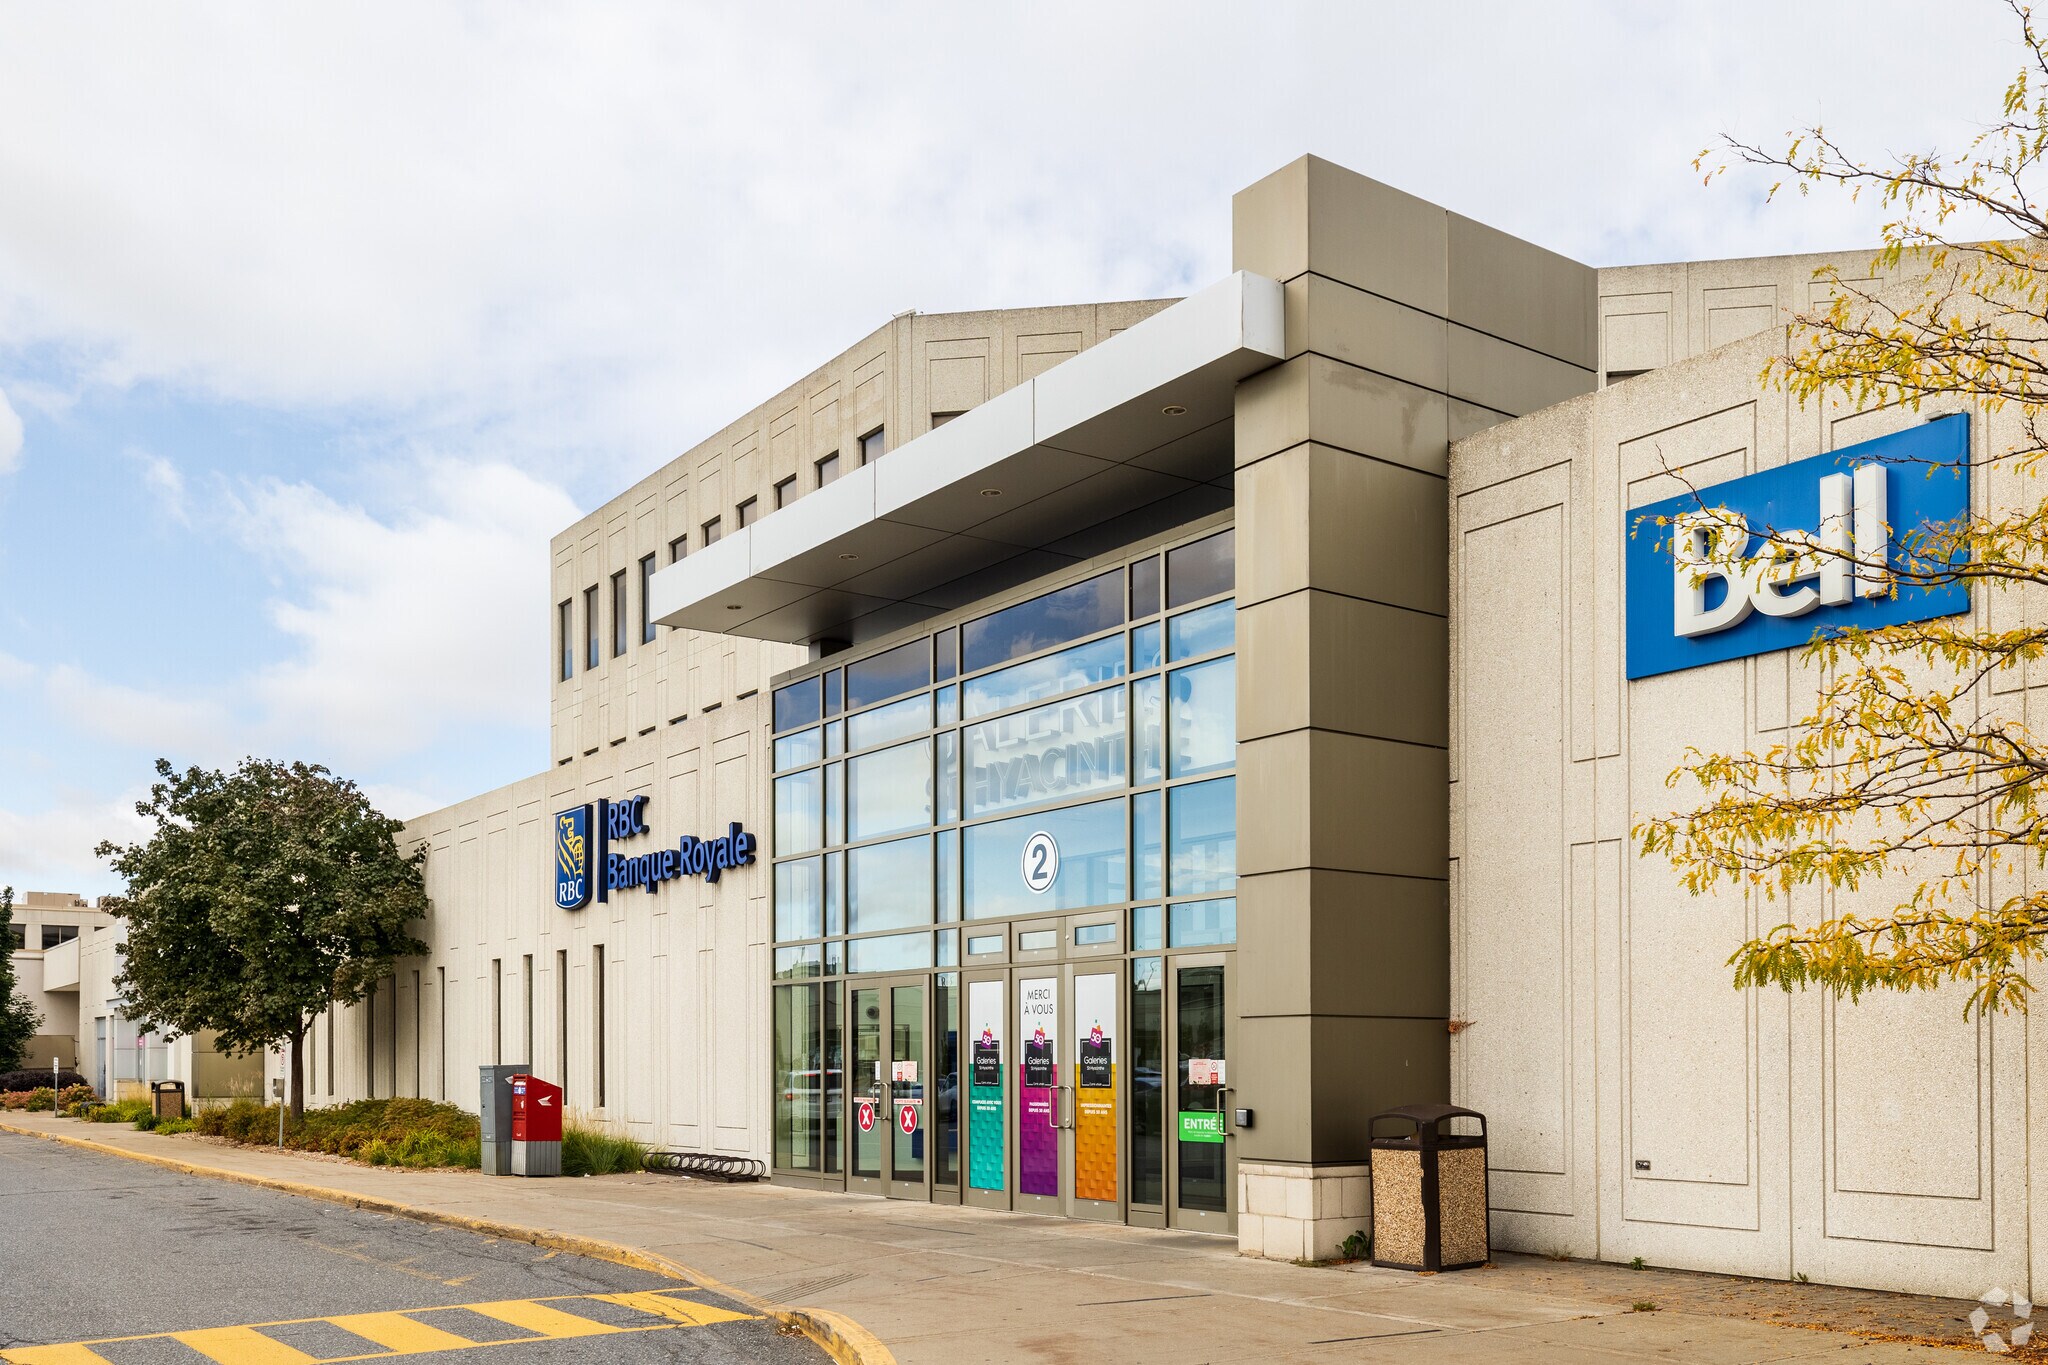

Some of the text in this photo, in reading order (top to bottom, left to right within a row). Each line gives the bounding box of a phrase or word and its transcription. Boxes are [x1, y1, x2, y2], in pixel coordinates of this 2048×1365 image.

[1674, 463, 1888, 638] Bell
[608, 795, 650, 840] RBC
[608, 822, 756, 894] Banque Royale
[1032, 843, 1048, 880] 2
[559, 878, 583, 902] RBC
[1027, 989, 1050, 1000] MERCI
[1024, 1002, 1054, 1015] À VOUS
[1034, 1034, 1044, 1045] 50
[1091, 1032, 1101, 1044] 50
[976, 1056, 996, 1065] Galeries
[1028, 1056, 1049, 1065] Galeries
[1084, 1056, 1107, 1064] Galeries
